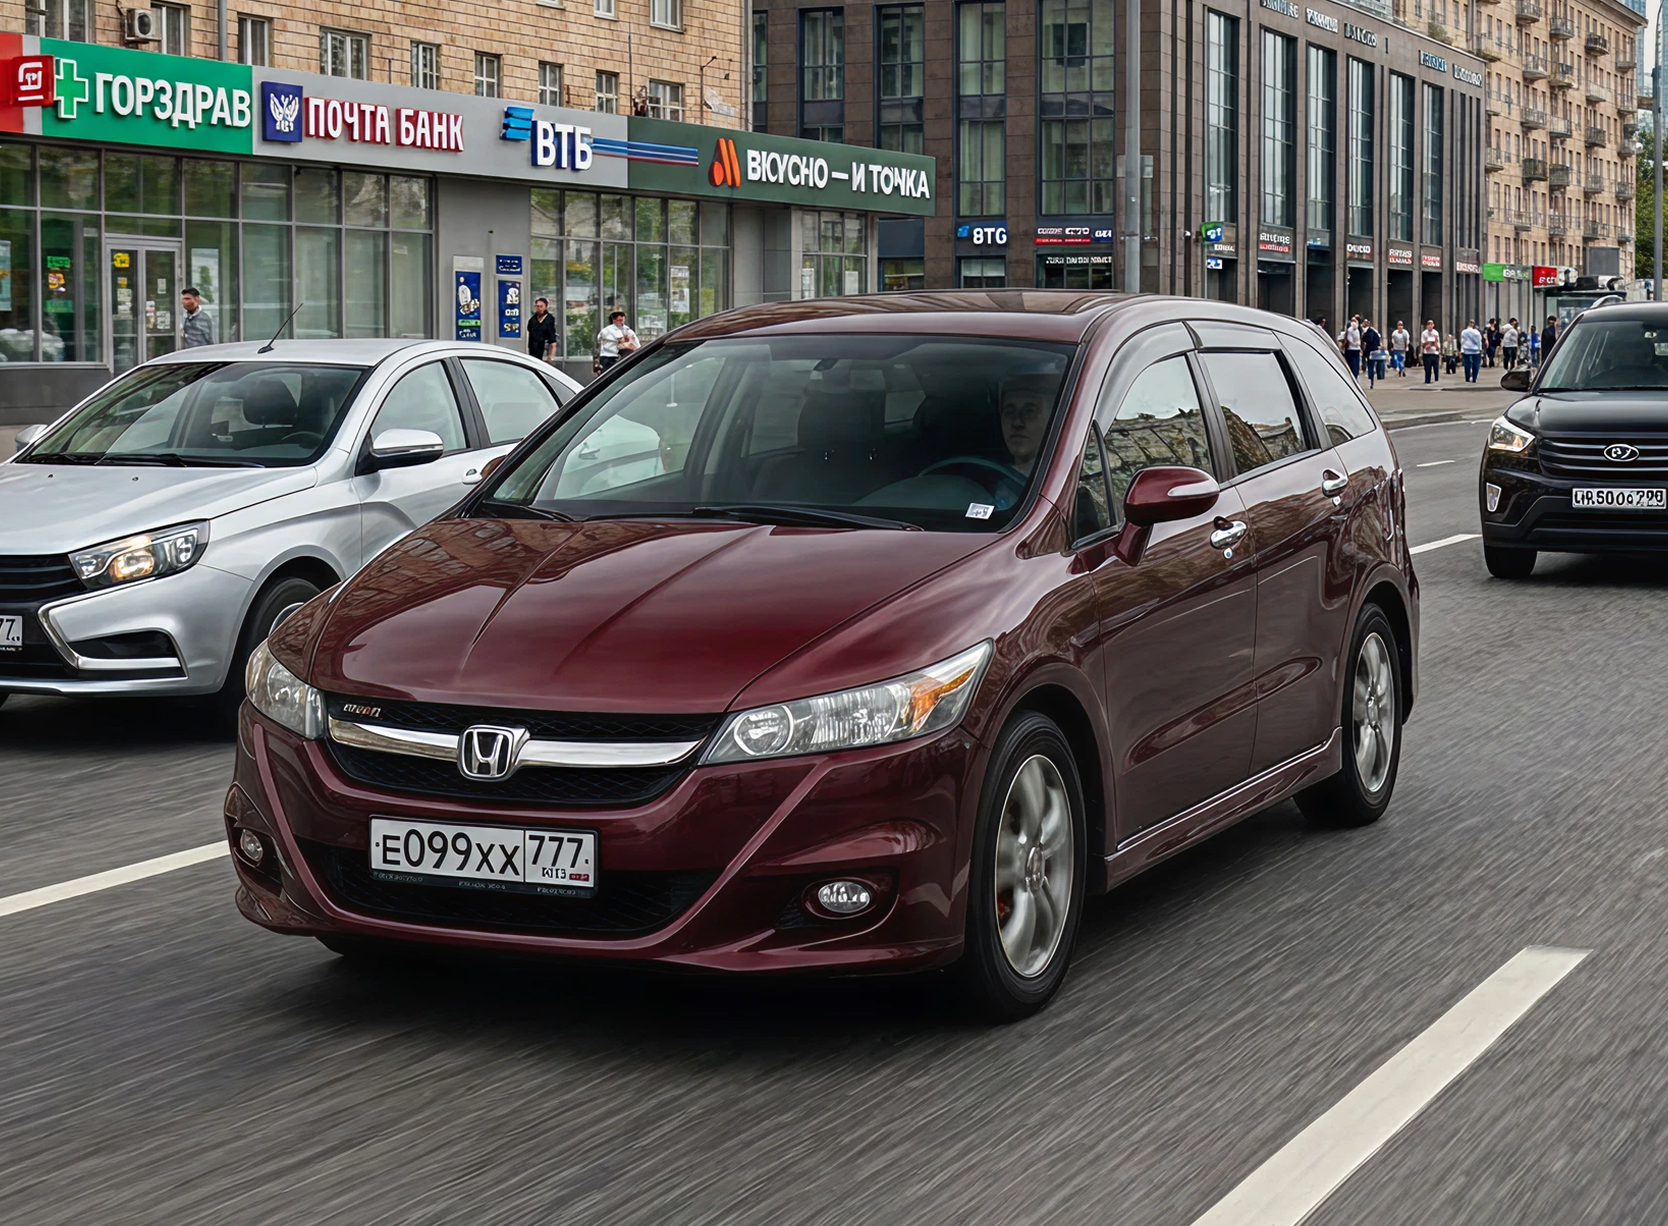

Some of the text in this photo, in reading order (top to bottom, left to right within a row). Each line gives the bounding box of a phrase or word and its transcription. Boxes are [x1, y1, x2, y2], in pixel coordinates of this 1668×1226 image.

[95, 72, 251, 129] ГОРЗДРАВ
[306, 97, 464, 152] ПОЧТА БАНК
[534, 119, 594, 171] ВТБ
[851, 161, 866, 193] И
[528, 834, 584, 869] 777
